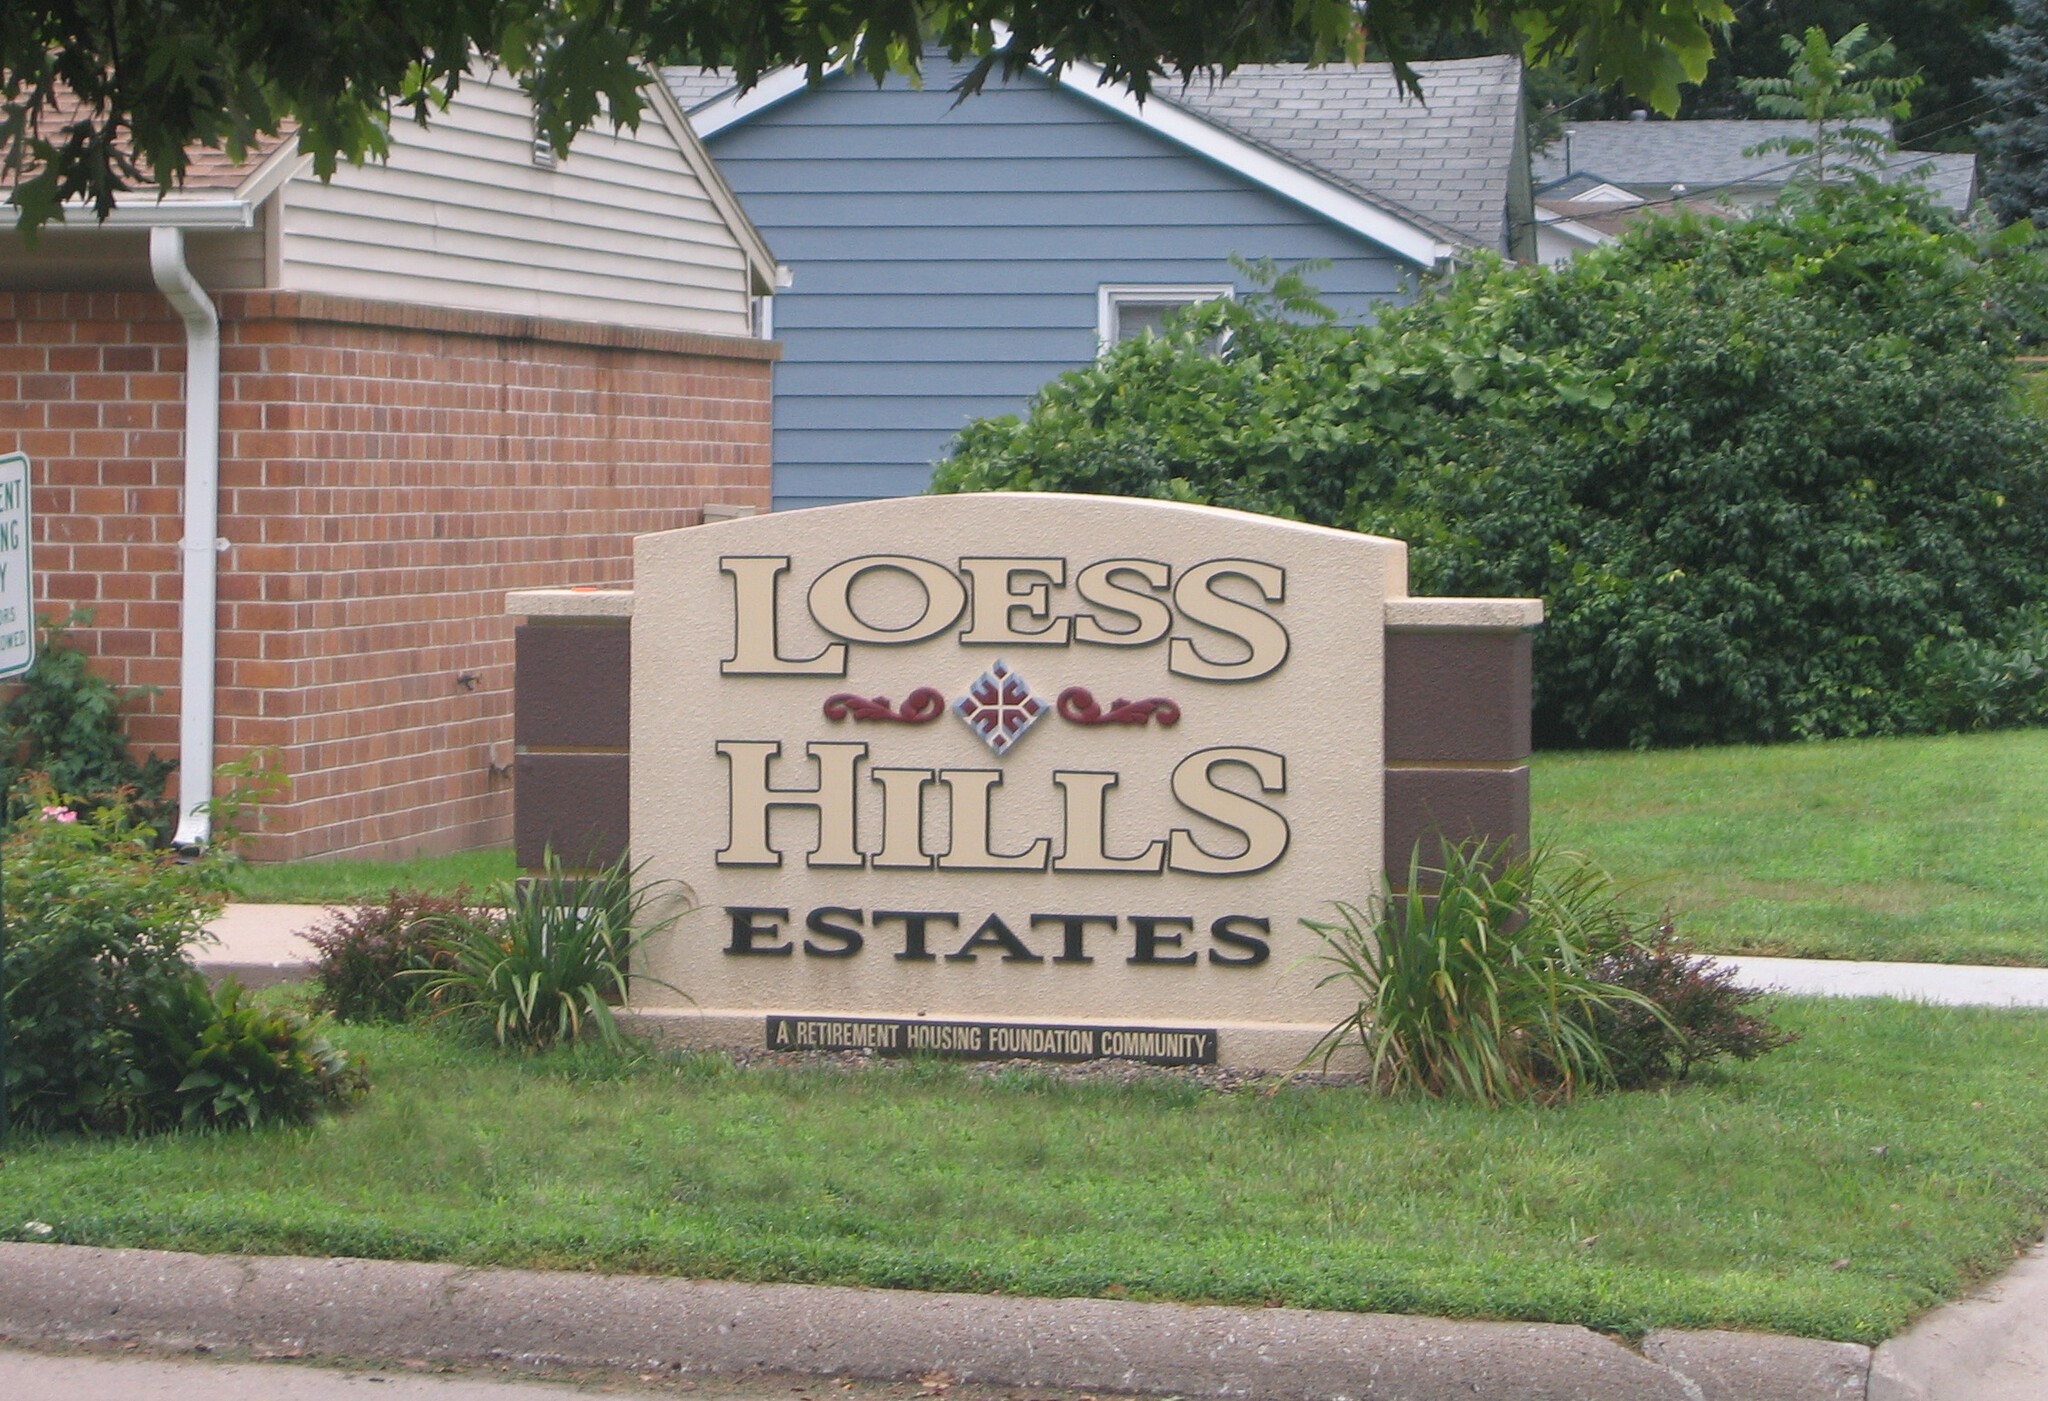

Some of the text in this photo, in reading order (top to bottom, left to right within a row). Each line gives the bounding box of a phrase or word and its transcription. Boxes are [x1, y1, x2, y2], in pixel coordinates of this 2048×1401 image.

[720, 554, 1290, 681] LOESS
[715, 740, 1290, 876] HILLS
[723, 906, 1272, 966] ESTATES
[776, 1019, 1208, 1058] A RETIREMENT HOUSING FOUNDATION COMMUNITY
